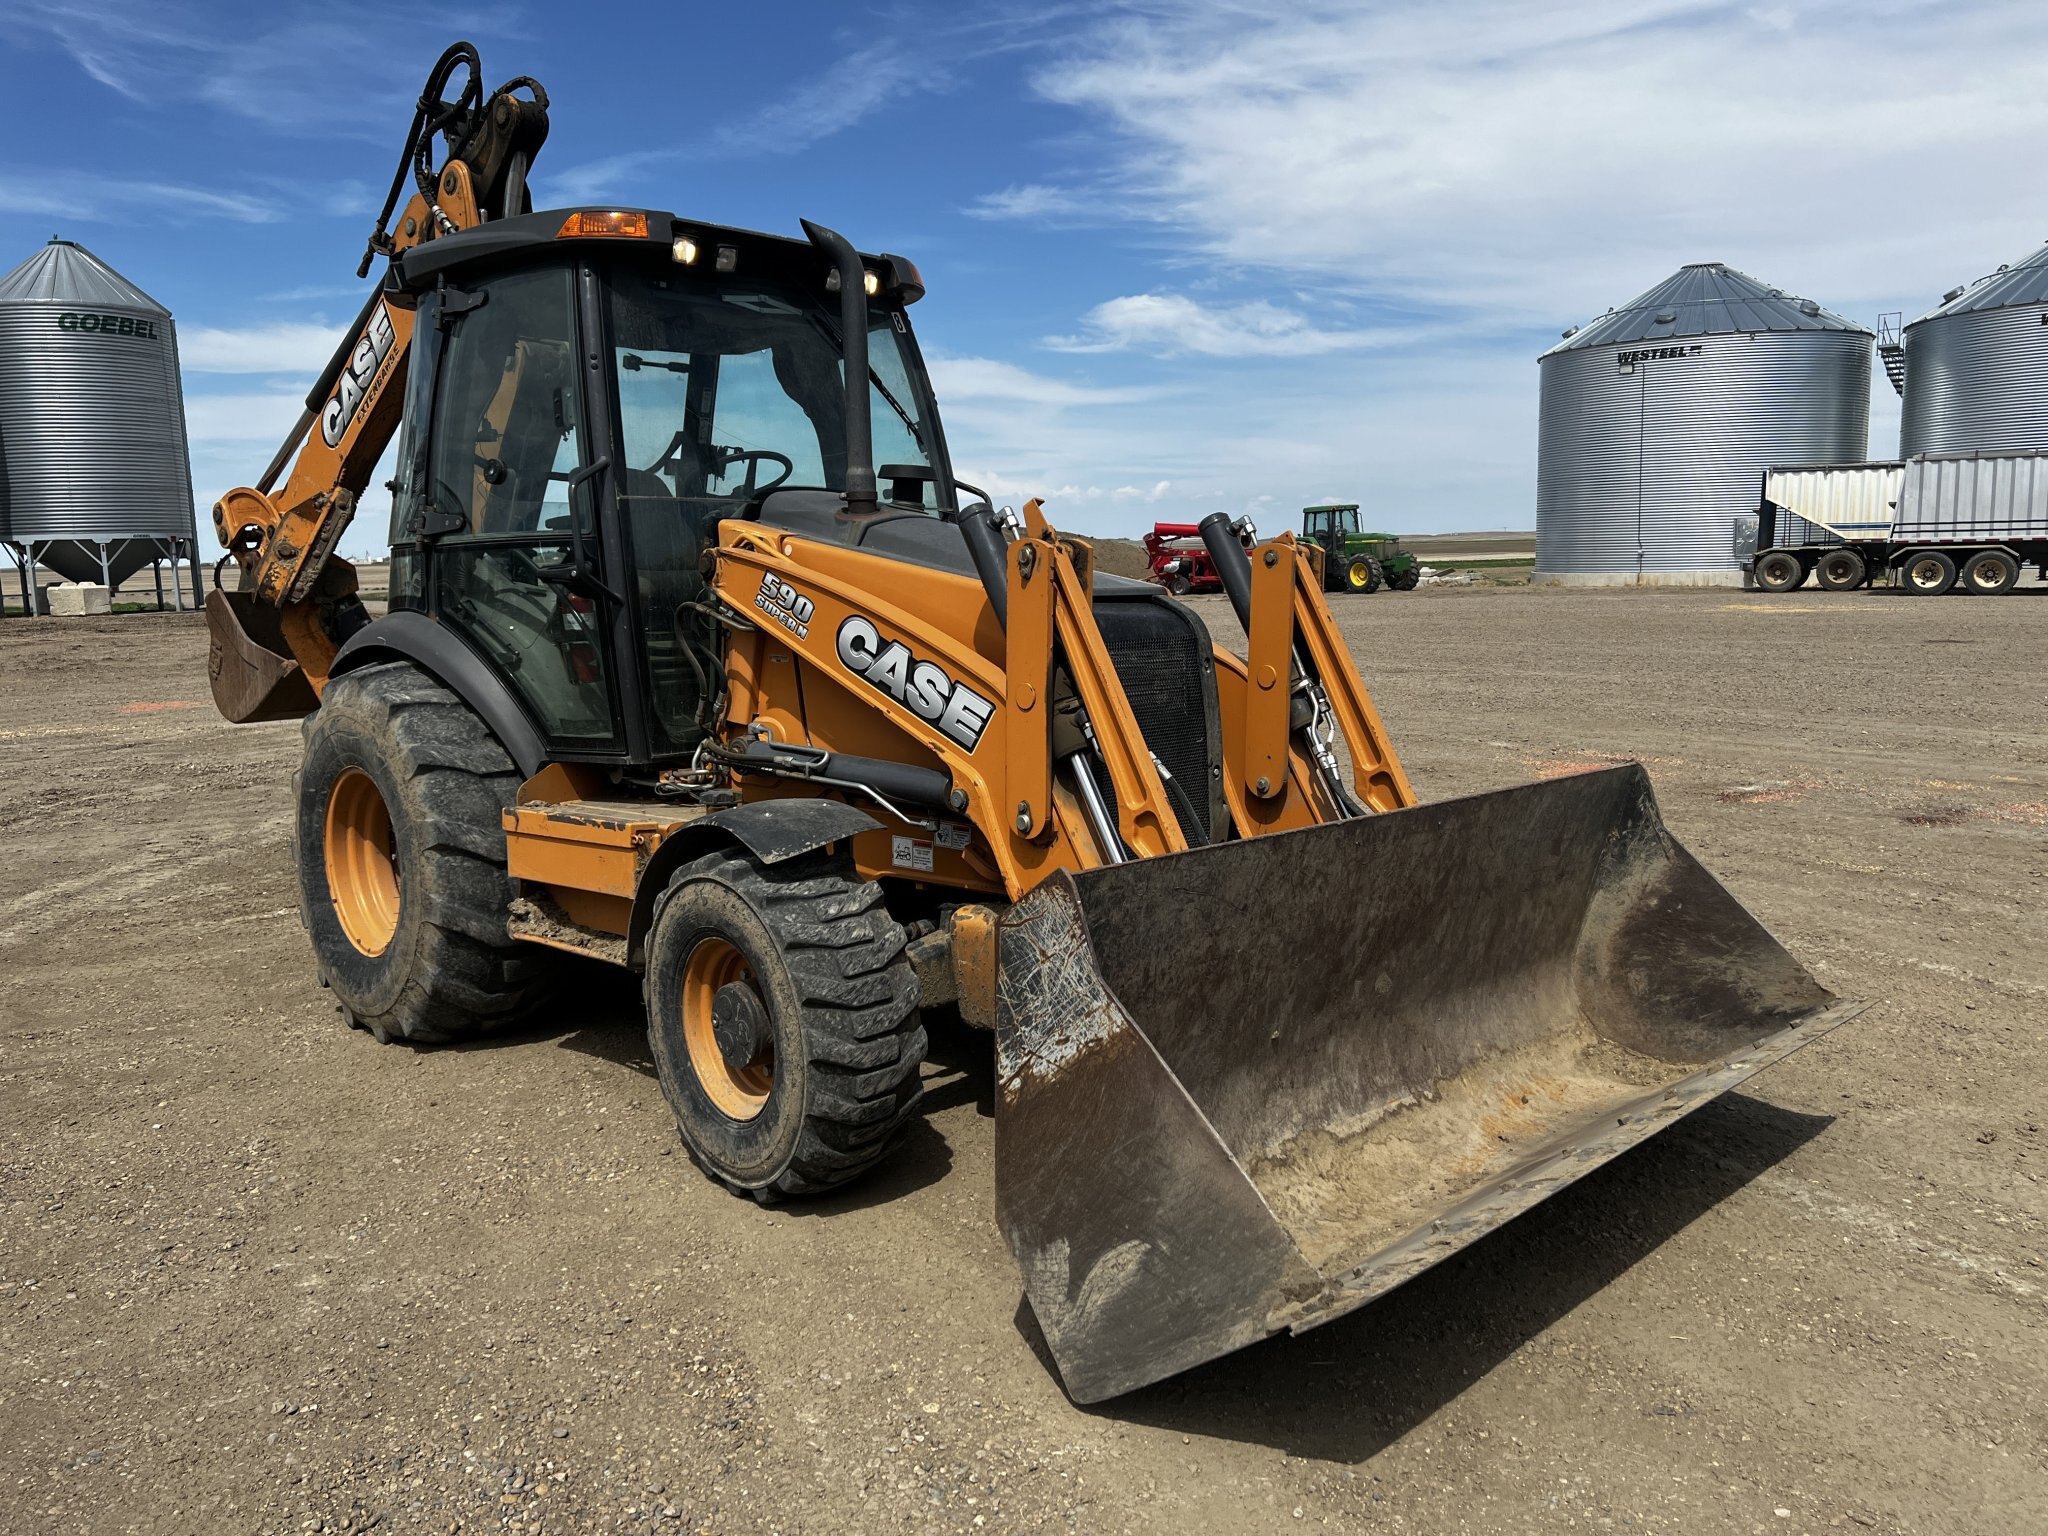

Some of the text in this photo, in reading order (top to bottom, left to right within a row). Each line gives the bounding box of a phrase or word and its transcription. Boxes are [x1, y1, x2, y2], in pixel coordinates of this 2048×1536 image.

[58, 312, 157, 340] GOEBEL
[893, 313, 903, 332] 8
[322, 300, 395, 447] CASE
[1618, 346, 1686, 363] WESTEEL
[755, 594, 808, 640] SUPER N
[760, 570, 815, 624] 590
[836, 615, 996, 752] CASE
